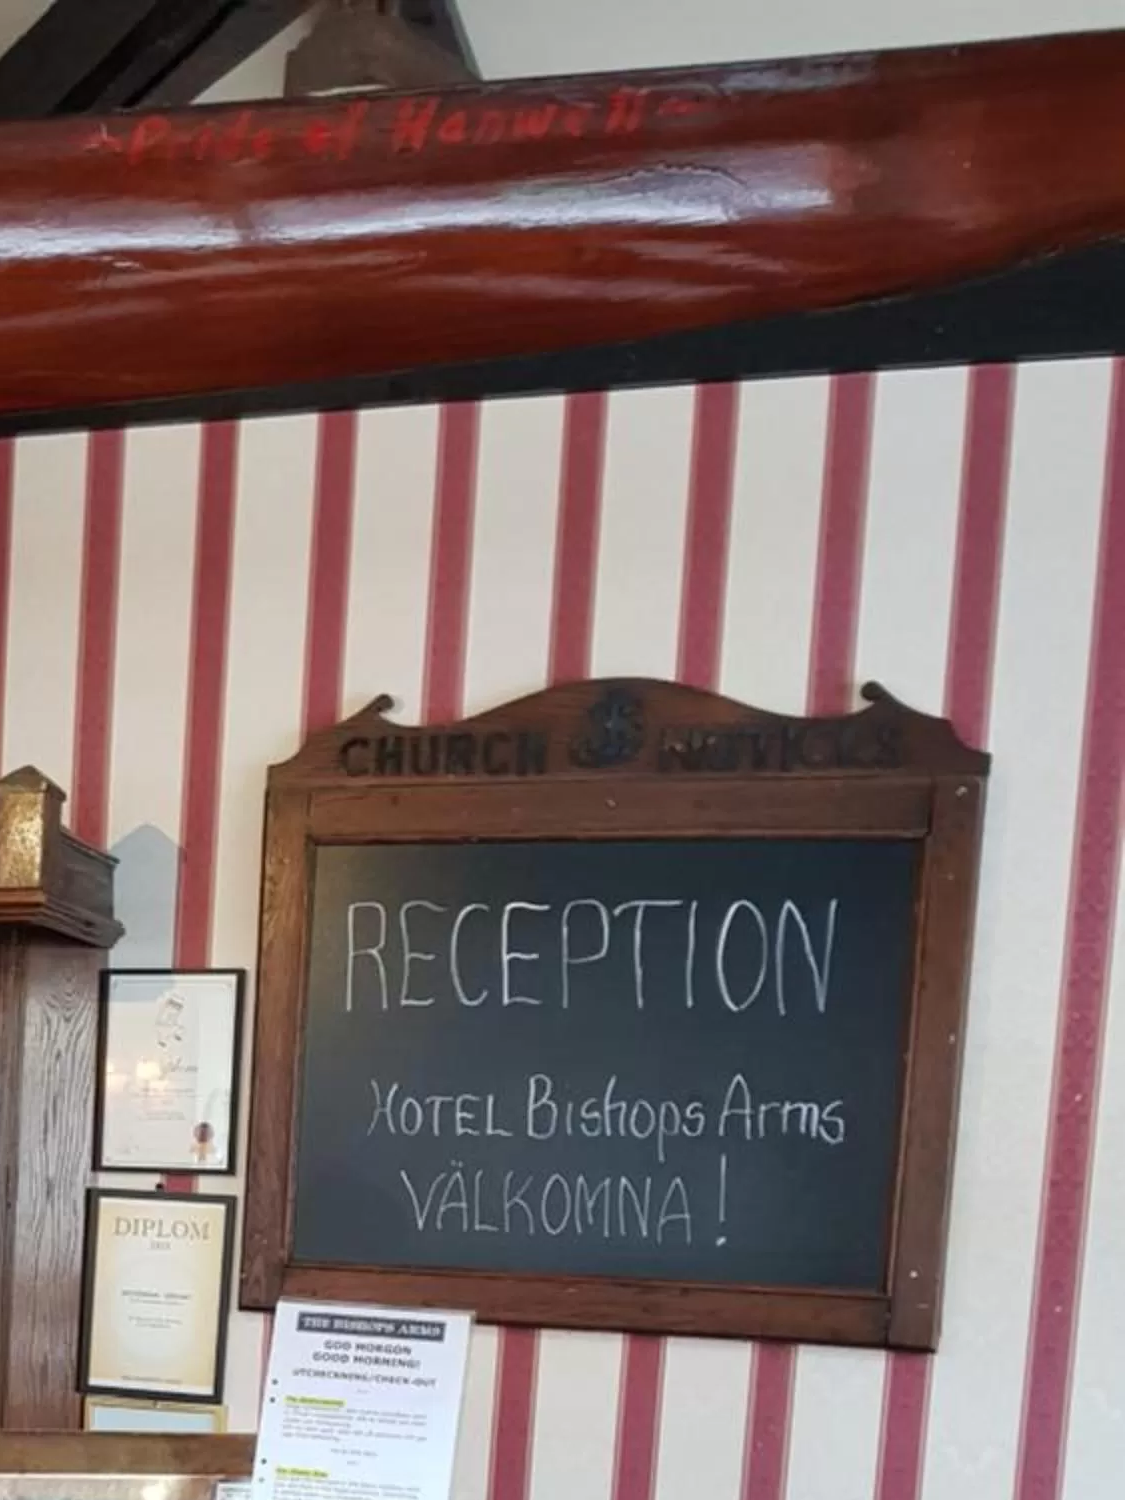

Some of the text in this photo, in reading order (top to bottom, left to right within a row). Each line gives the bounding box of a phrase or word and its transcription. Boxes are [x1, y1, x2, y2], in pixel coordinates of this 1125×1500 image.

[338, 732, 551, 777] CHURCH
[345, 898, 838, 1015] RECEPTION
[367, 1072, 846, 1163] HOTEL Bishops Arms
[113, 1215, 211, 1241] DIPLOM
[312, 1351, 350, 1364] GOOD
[323, 1339, 352, 1351] GOD
